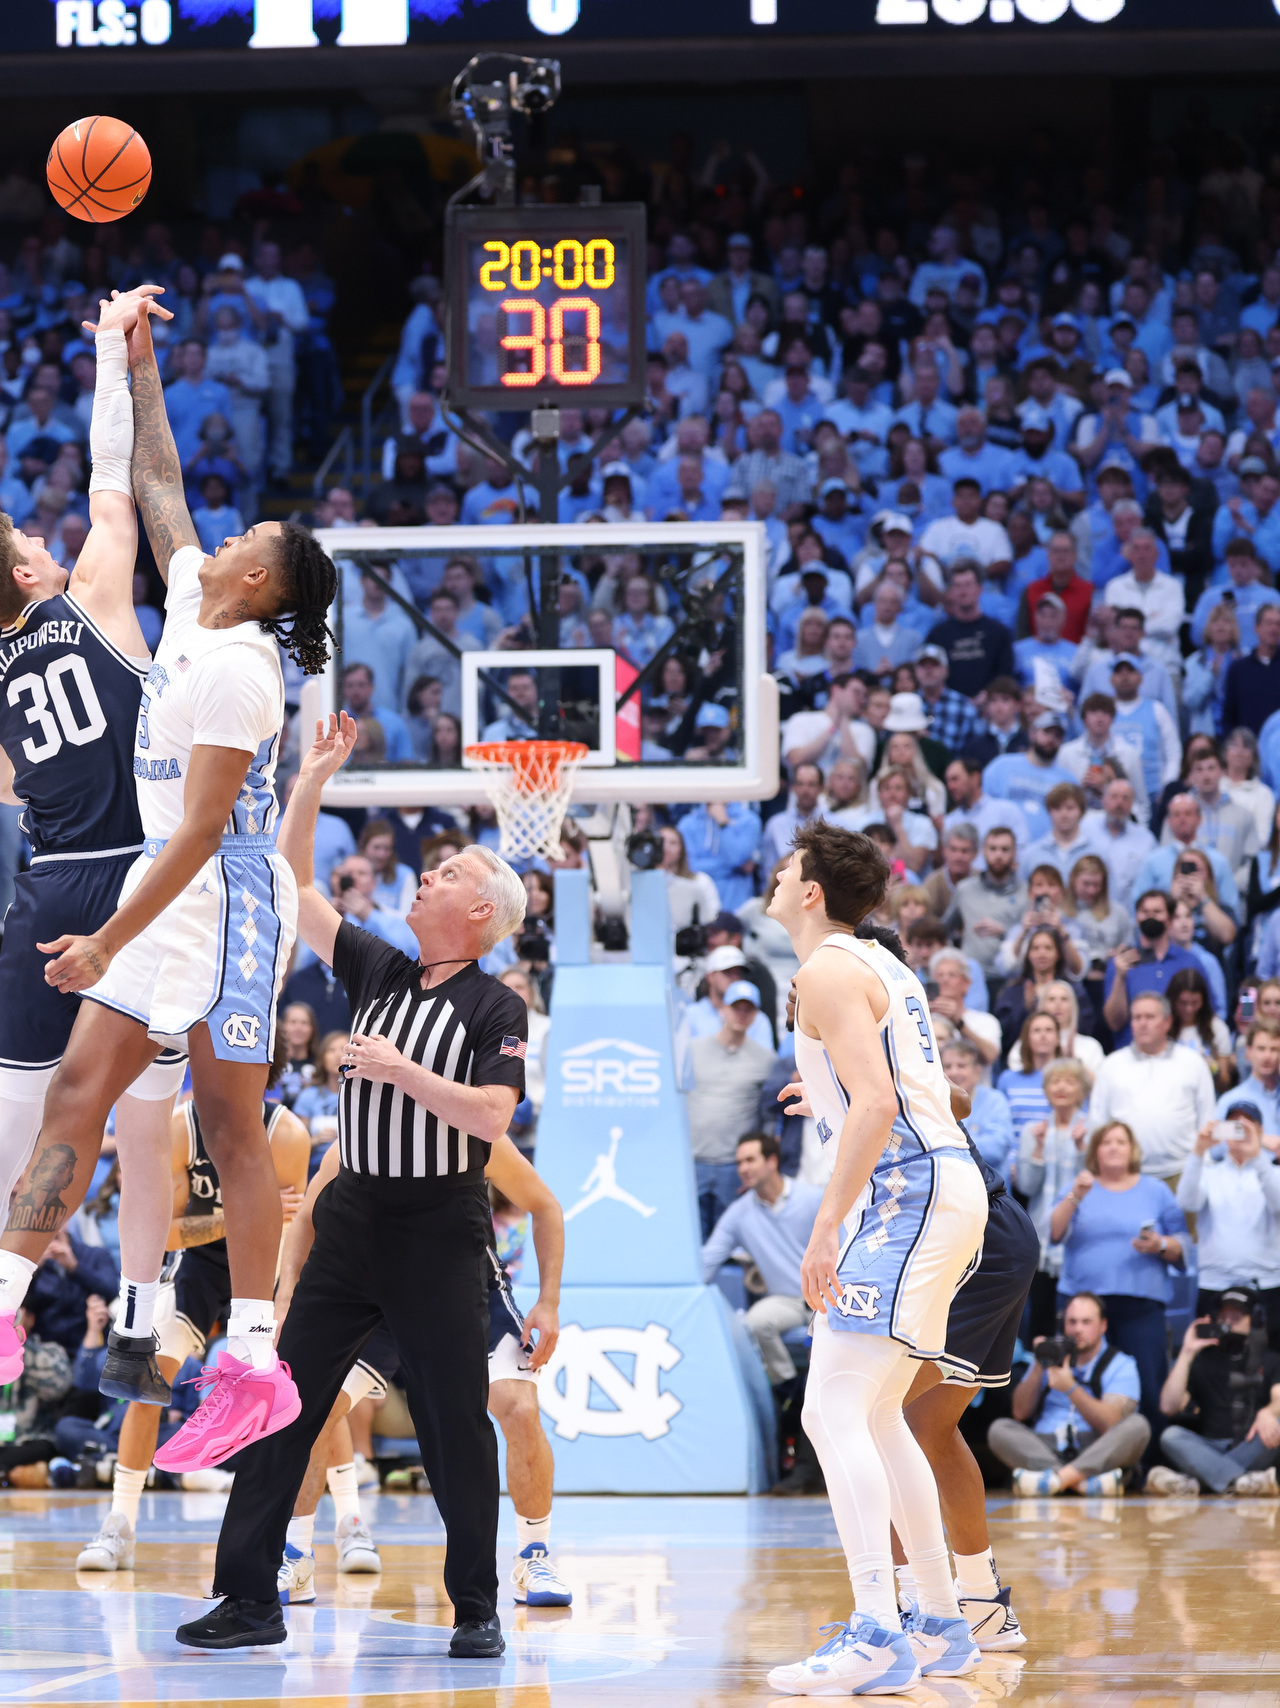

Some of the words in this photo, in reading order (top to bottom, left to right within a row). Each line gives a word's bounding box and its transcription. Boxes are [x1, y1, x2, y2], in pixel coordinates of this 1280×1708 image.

[479, 238, 616, 292] 20:00
[500, 297, 601, 387] 30
[6, 653, 108, 764] 30
[905, 996, 934, 1063] 3
[560, 1059, 662, 1094] SRS
[562, 1096, 660, 1108] DISTRIBUTION
